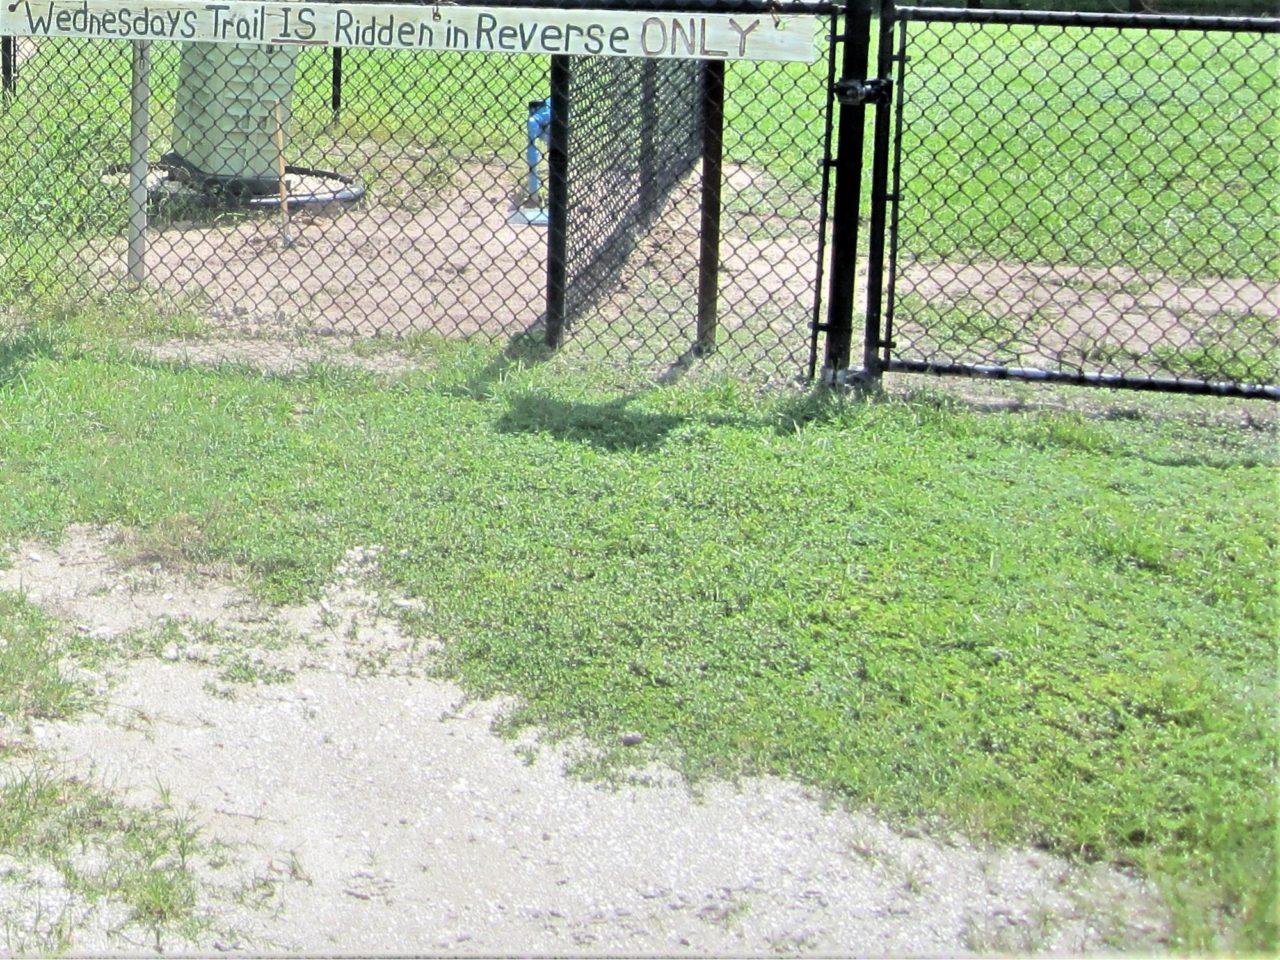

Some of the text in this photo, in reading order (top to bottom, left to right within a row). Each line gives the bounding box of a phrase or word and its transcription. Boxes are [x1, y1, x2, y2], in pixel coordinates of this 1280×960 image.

[25, 1, 761, 57] Wednesdays Trail IS Ridden in Reverse ONLY
